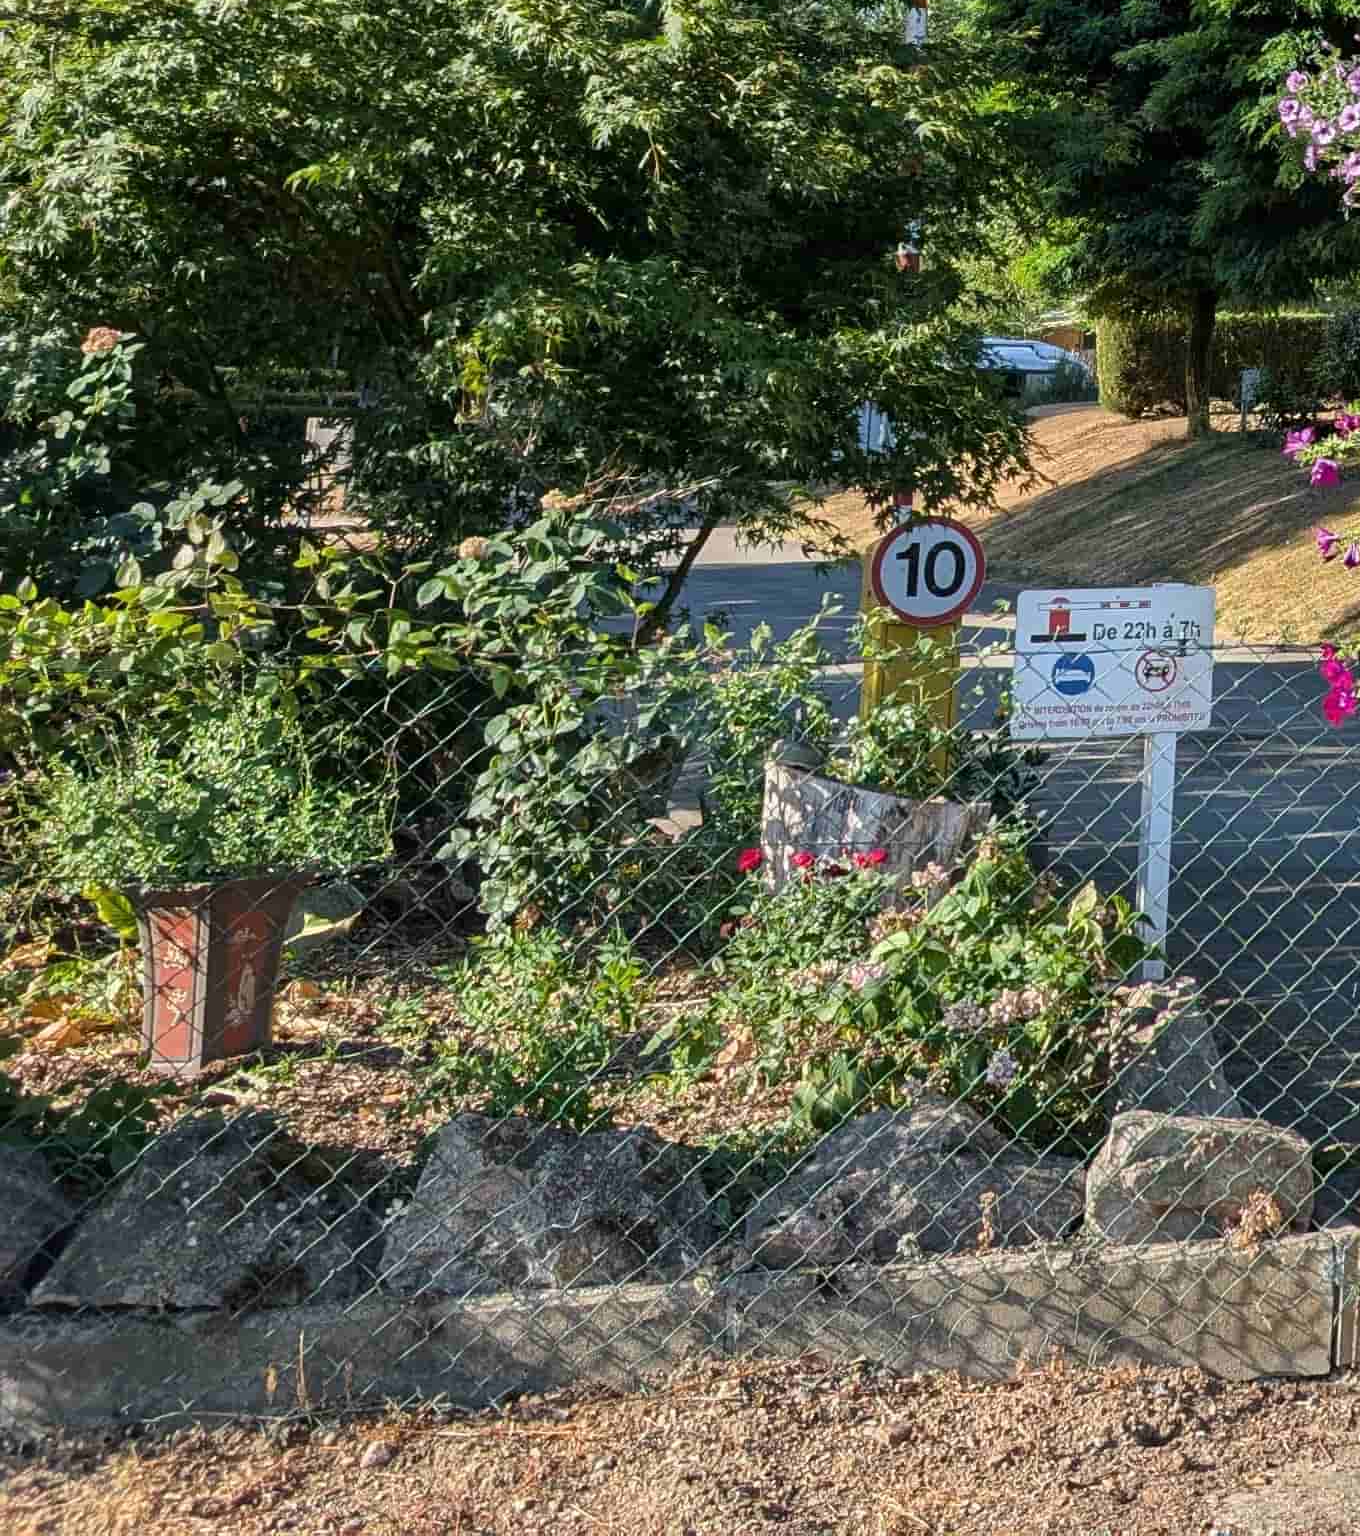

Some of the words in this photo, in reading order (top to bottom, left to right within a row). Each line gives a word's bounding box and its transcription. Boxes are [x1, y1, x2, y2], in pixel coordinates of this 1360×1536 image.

[896, 541, 965, 597] 10
[1093, 623, 1117, 641] De
[1124, 621, 1156, 640] 22h
[1180, 620, 1200, 638] 7h
